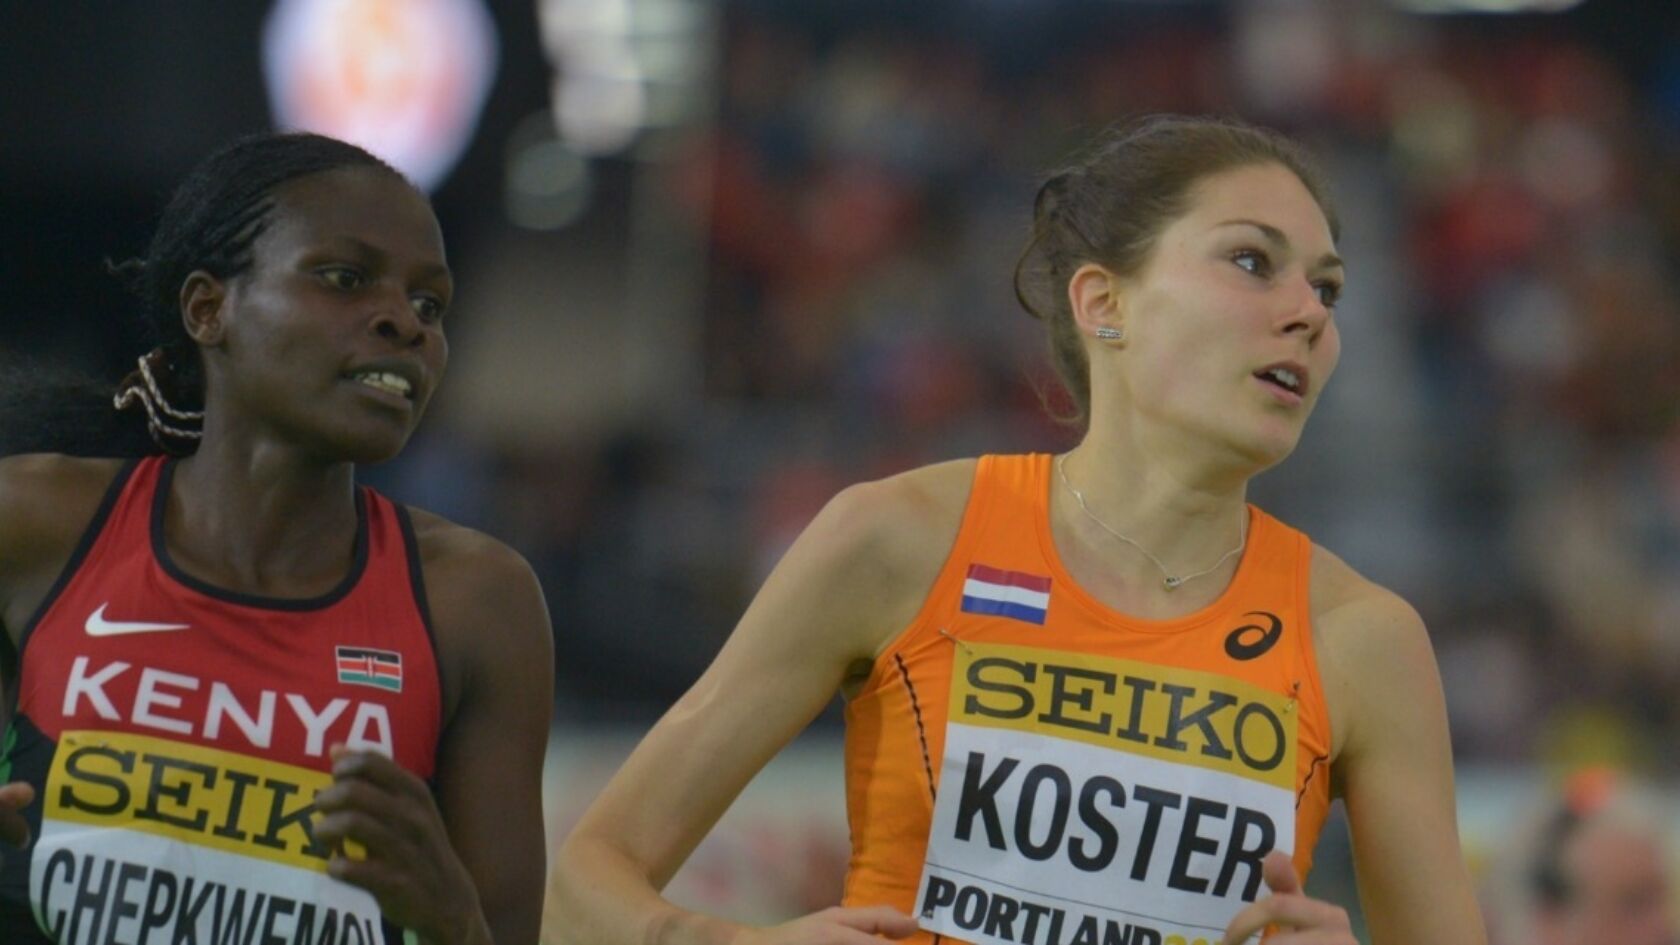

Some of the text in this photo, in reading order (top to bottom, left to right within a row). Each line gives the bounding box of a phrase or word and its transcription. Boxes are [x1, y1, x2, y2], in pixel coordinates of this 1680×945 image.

[62, 656, 394, 759] KENYA
[963, 657, 1286, 771] SEIKO
[58, 745, 332, 859] SEIK
[954, 751, 1276, 902] KOSTER
[41, 848, 377, 945] CHEPKWE
